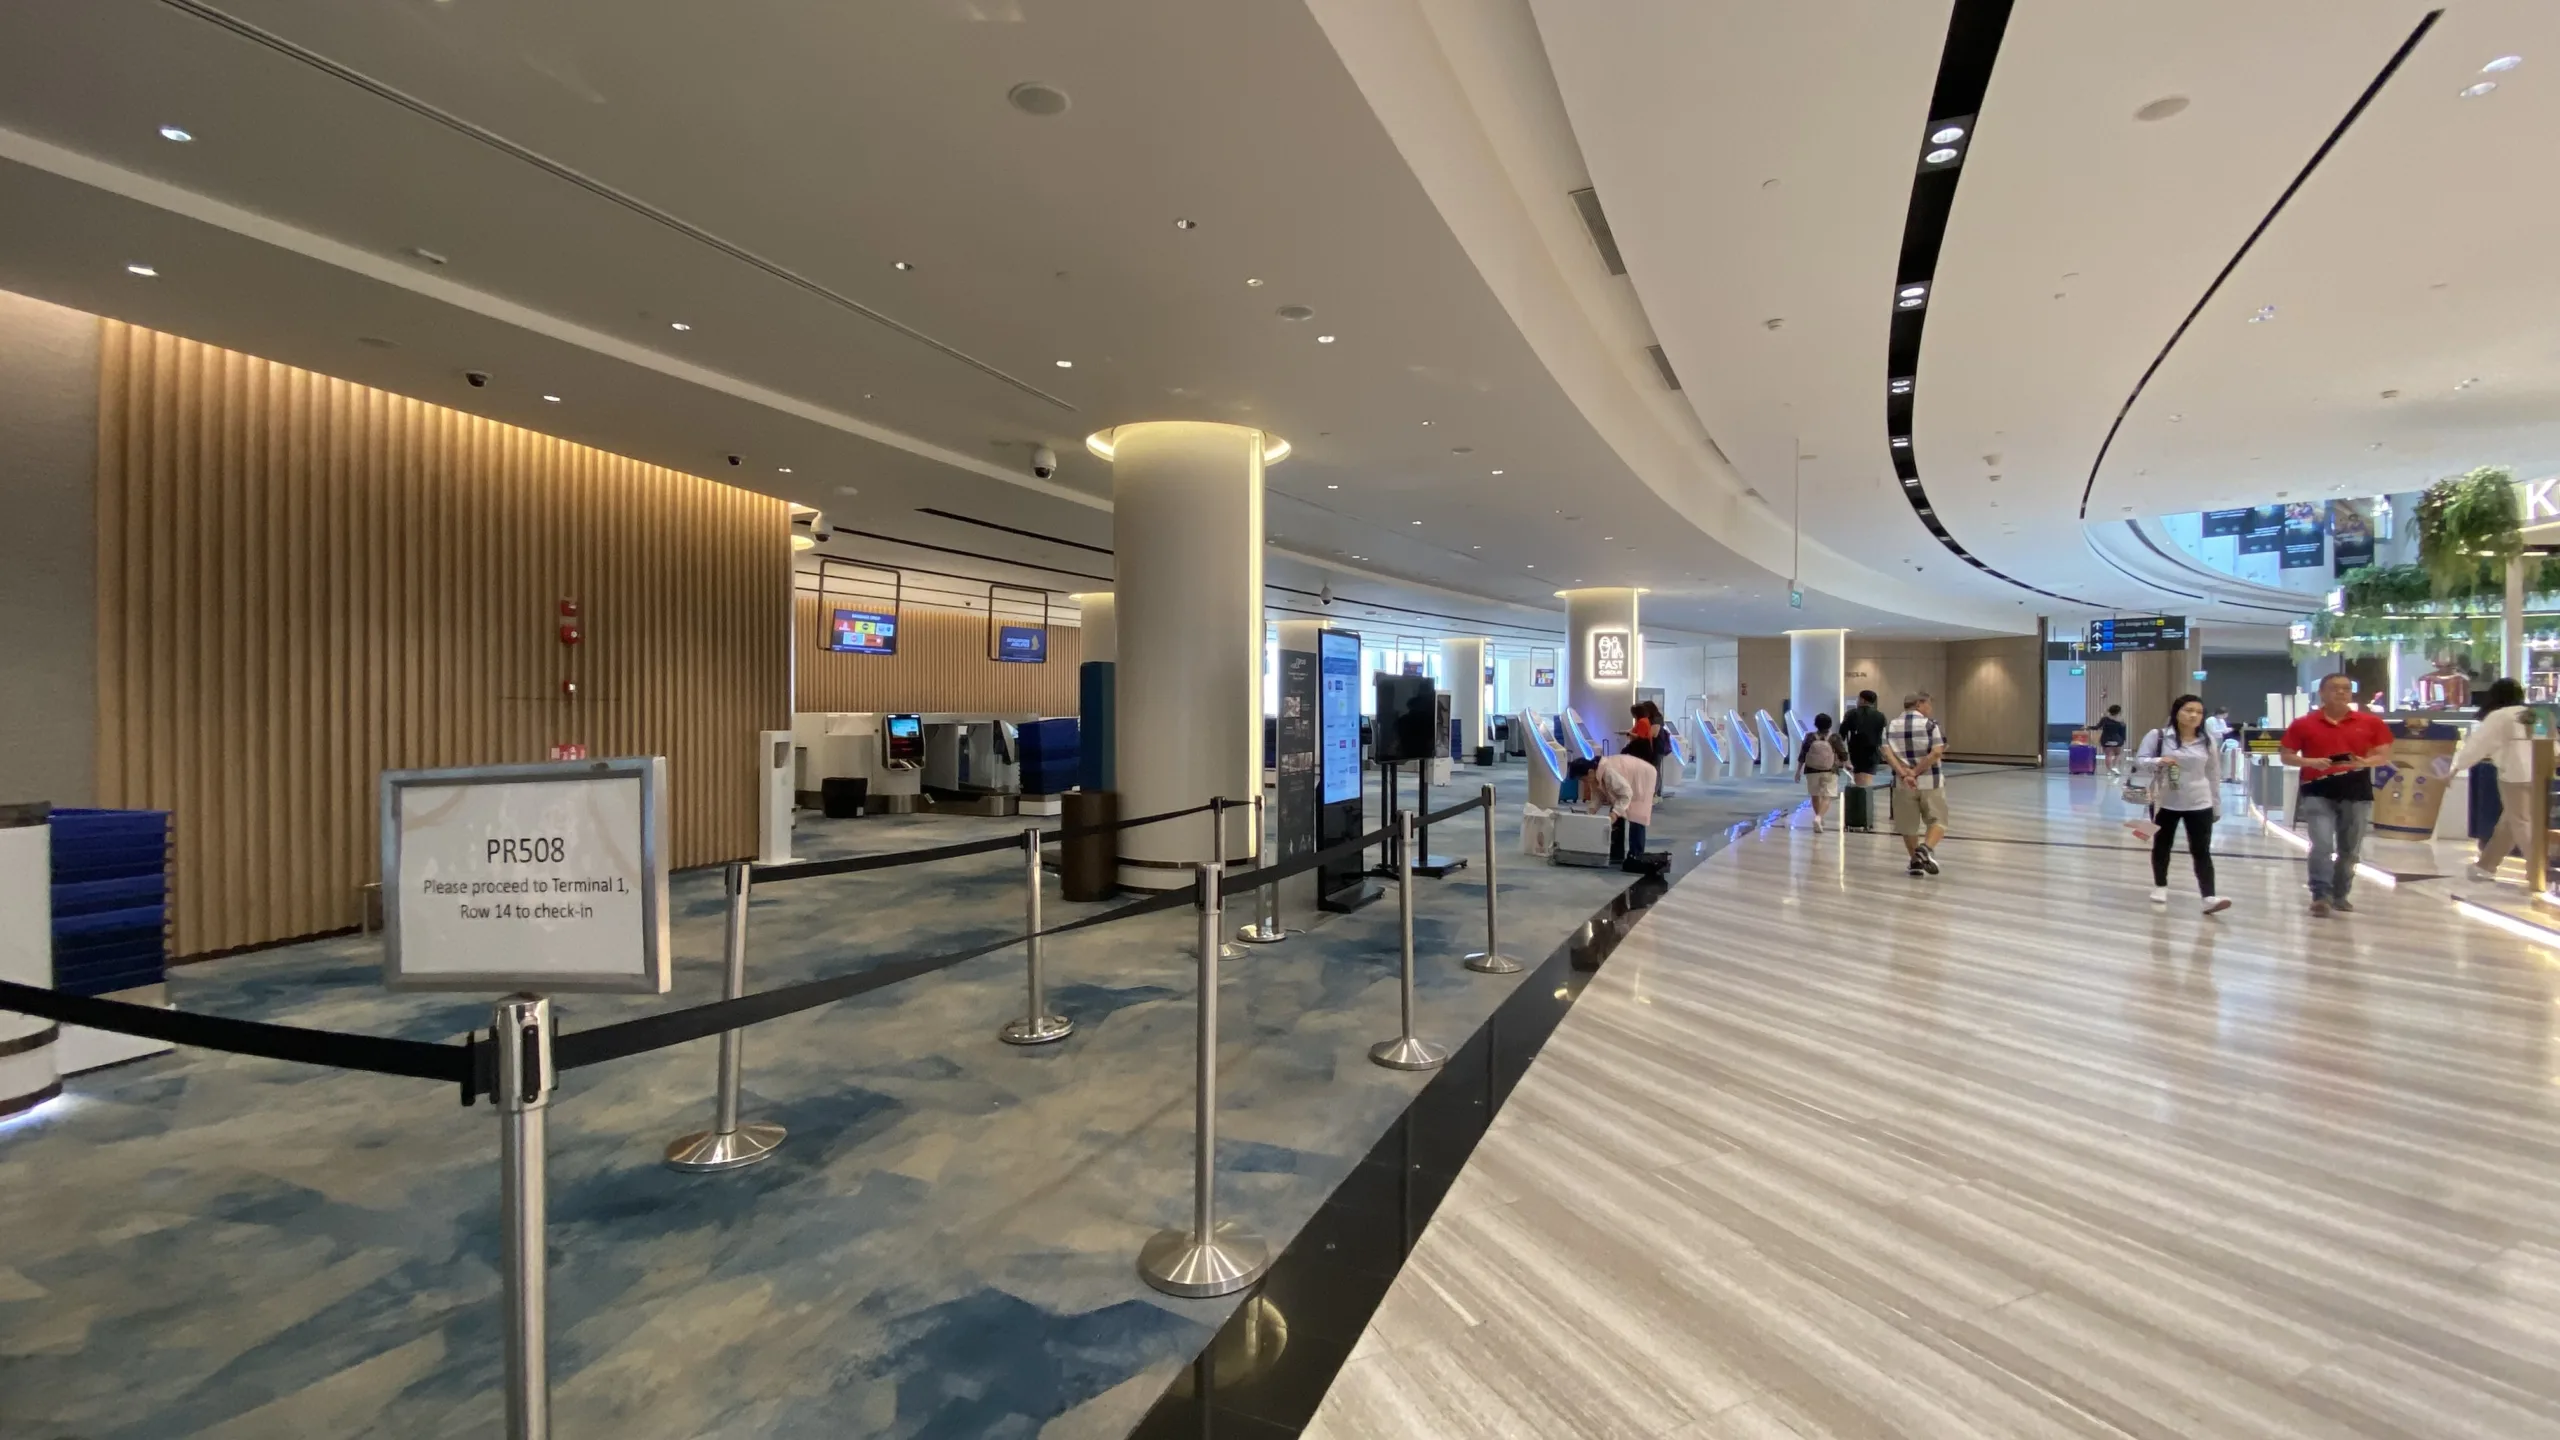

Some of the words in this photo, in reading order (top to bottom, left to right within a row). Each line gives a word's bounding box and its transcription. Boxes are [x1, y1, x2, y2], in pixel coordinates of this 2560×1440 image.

[1598, 659, 1624, 670] FAST
[487, 837, 565, 864] PR508
[423, 879, 468, 894] Please
[472, 878, 529, 897] proceed
[533, 880, 548, 893] to
[552, 876, 613, 893] Terminal
[617, 877, 630, 895] 1,
[460, 904, 491, 919] Row
[495, 904, 512, 919] 14
[516, 904, 531, 919] to
[534, 902, 593, 919] check-in
